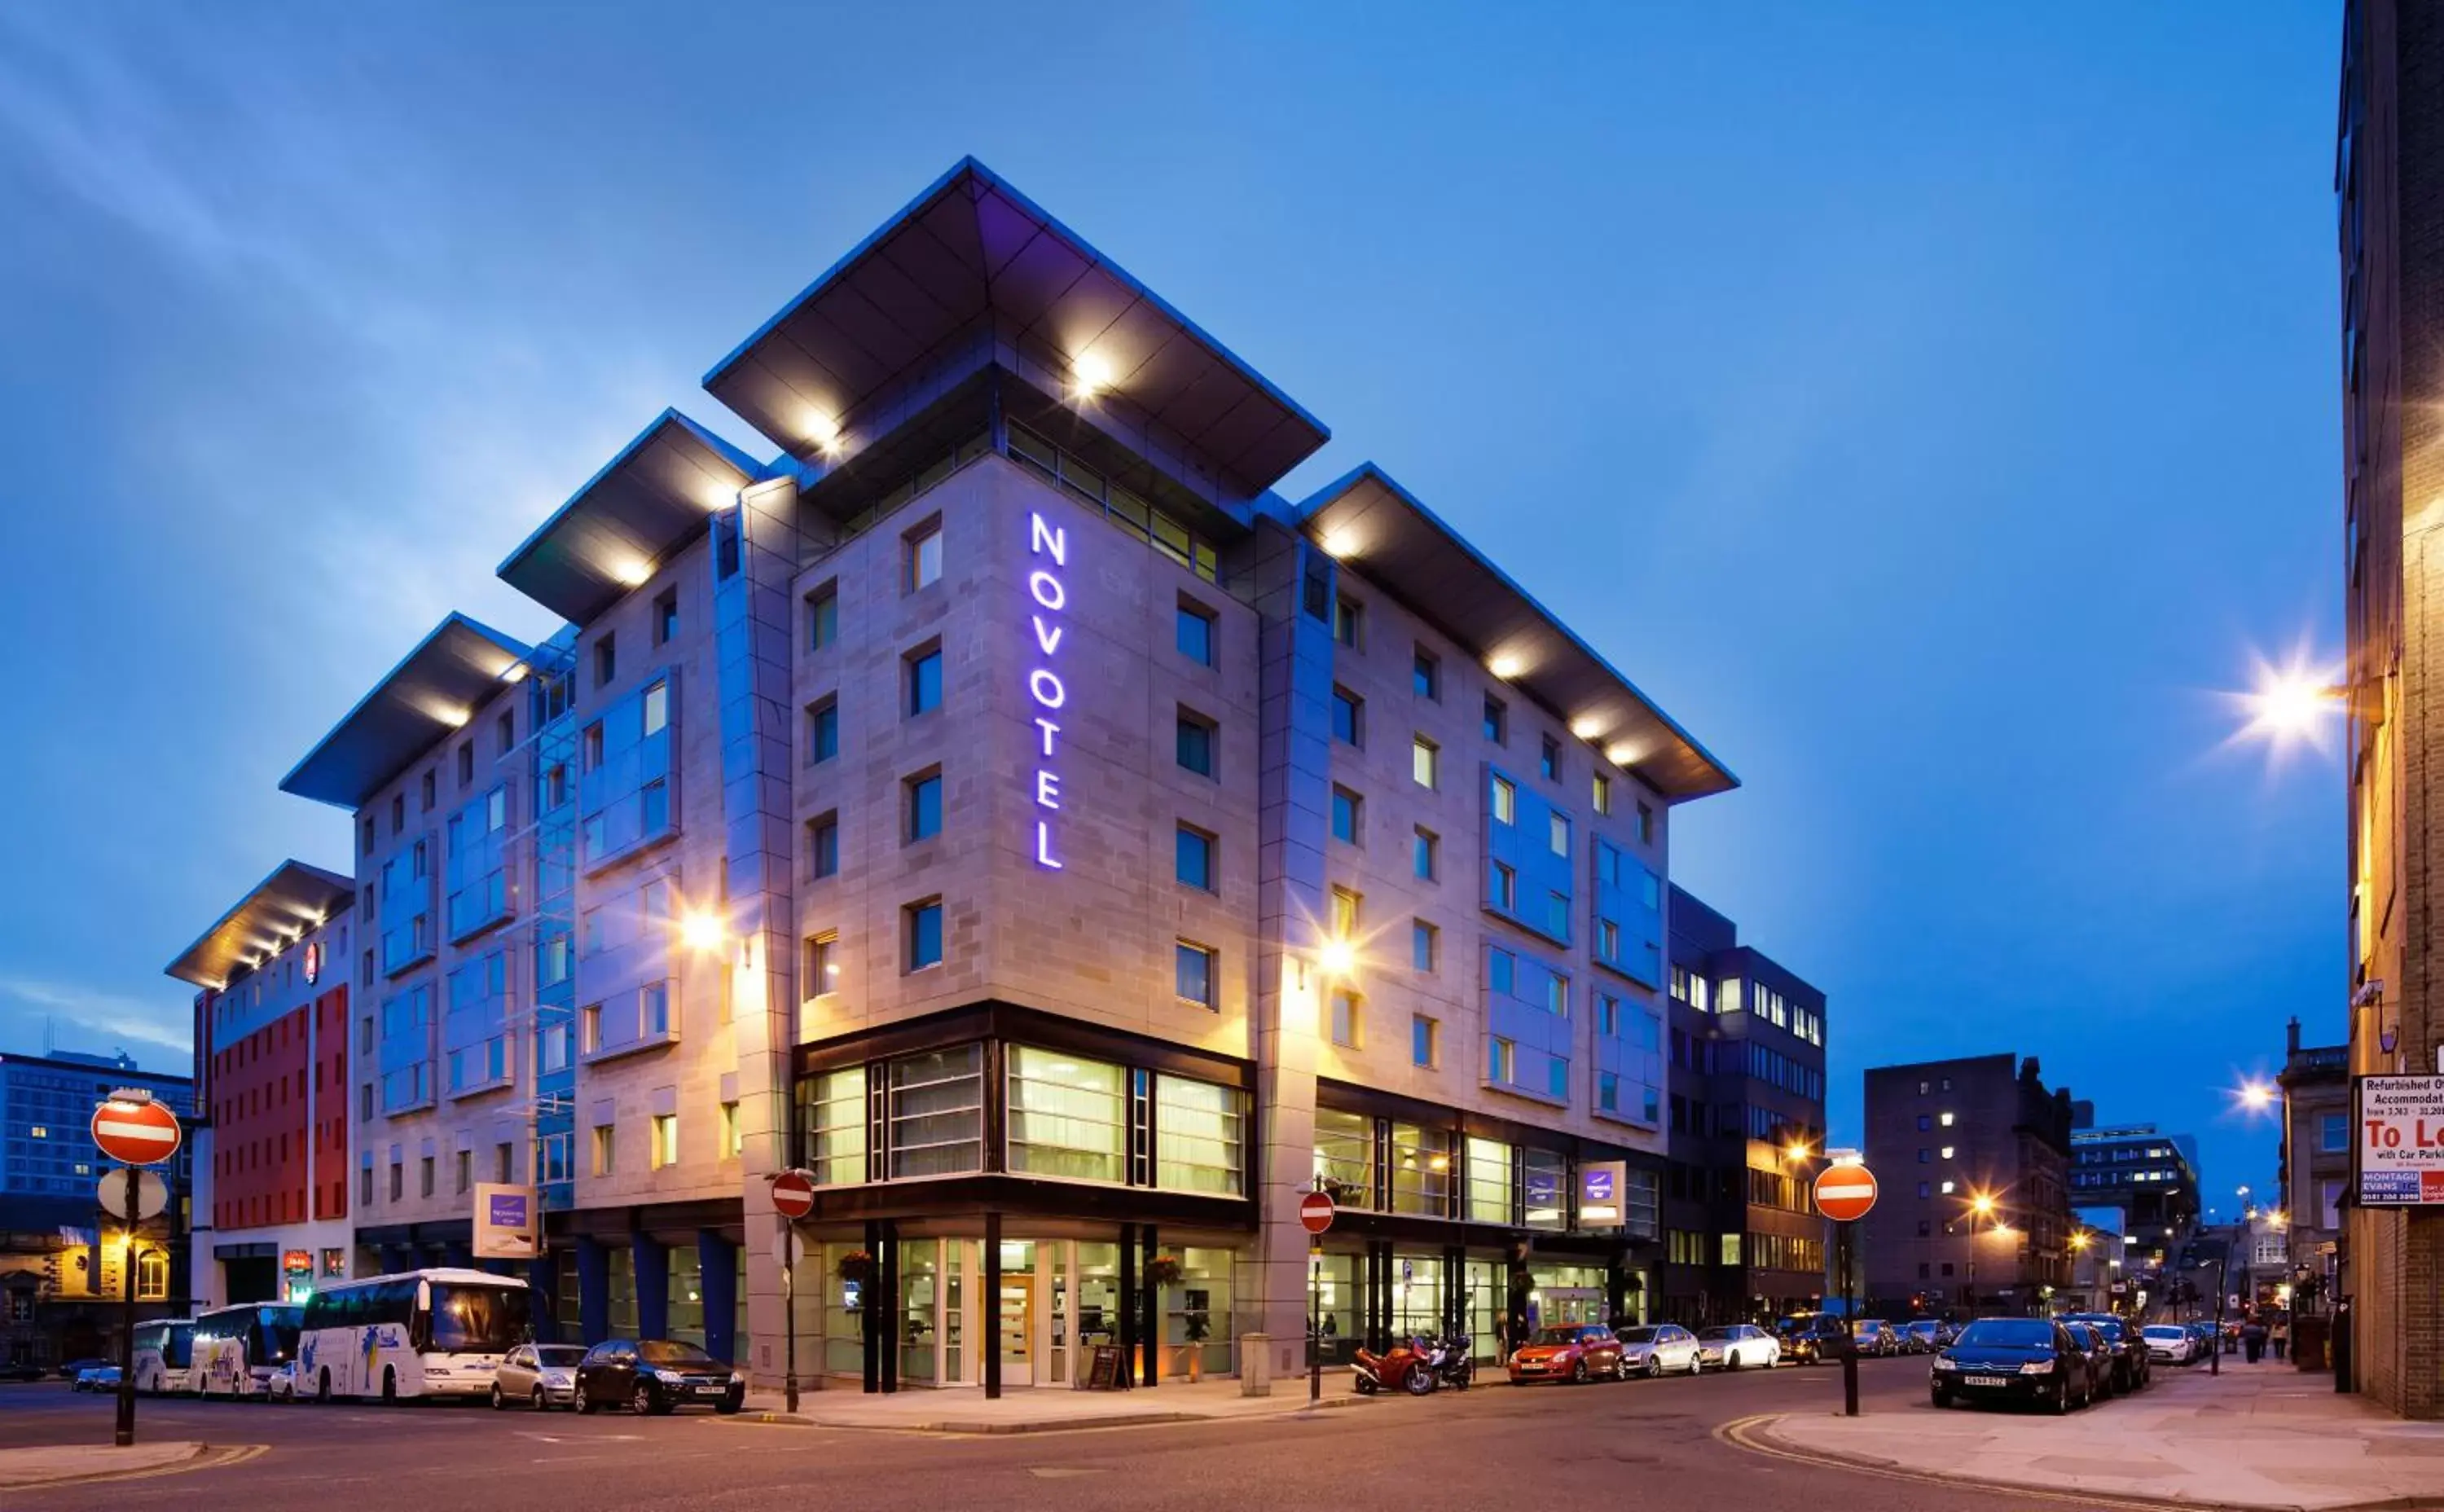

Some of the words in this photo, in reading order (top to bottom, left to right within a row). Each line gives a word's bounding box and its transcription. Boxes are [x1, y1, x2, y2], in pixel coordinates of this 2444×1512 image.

[1029, 511, 1066, 869] NOVOTEL
[2367, 1079, 2430, 1091] Refurbished
[2365, 1120, 2401, 1148] To
[2376, 1150, 2396, 1159] with
[2399, 1149, 2415, 1159] Car
[2363, 1172, 2419, 1181] MONTAGU
[2363, 1182, 2398, 1190] EVANS
